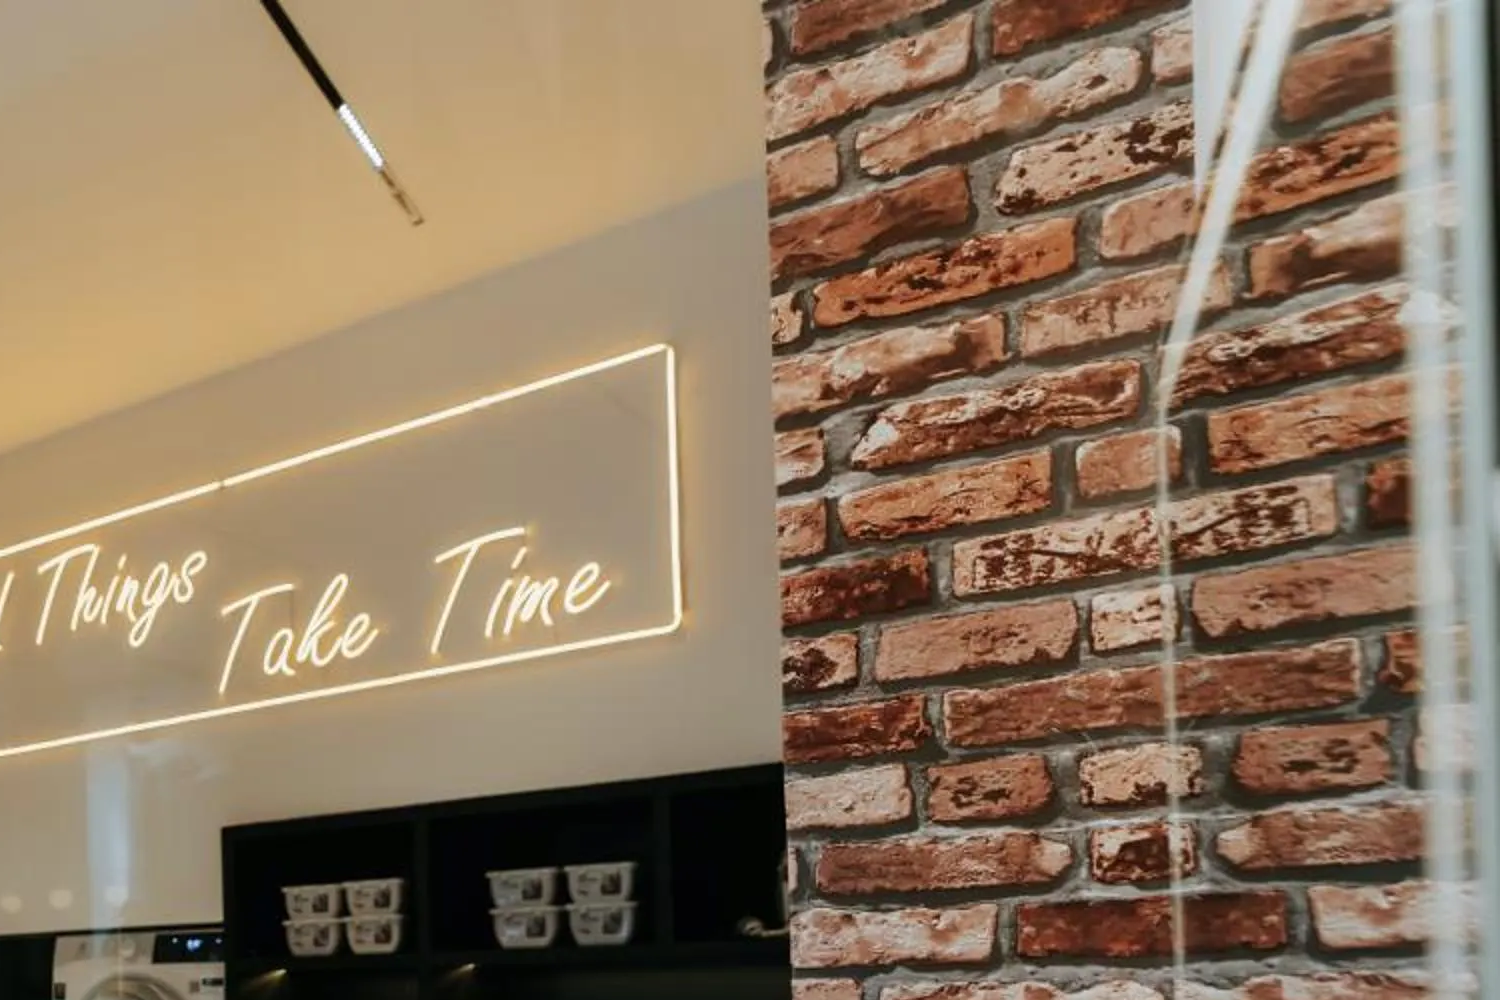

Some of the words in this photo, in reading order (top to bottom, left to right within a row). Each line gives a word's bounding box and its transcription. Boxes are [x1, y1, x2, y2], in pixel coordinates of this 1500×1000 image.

[34, 542, 209, 649] Things
[218, 572, 380, 696] Take
[429, 525, 612, 656] Time
